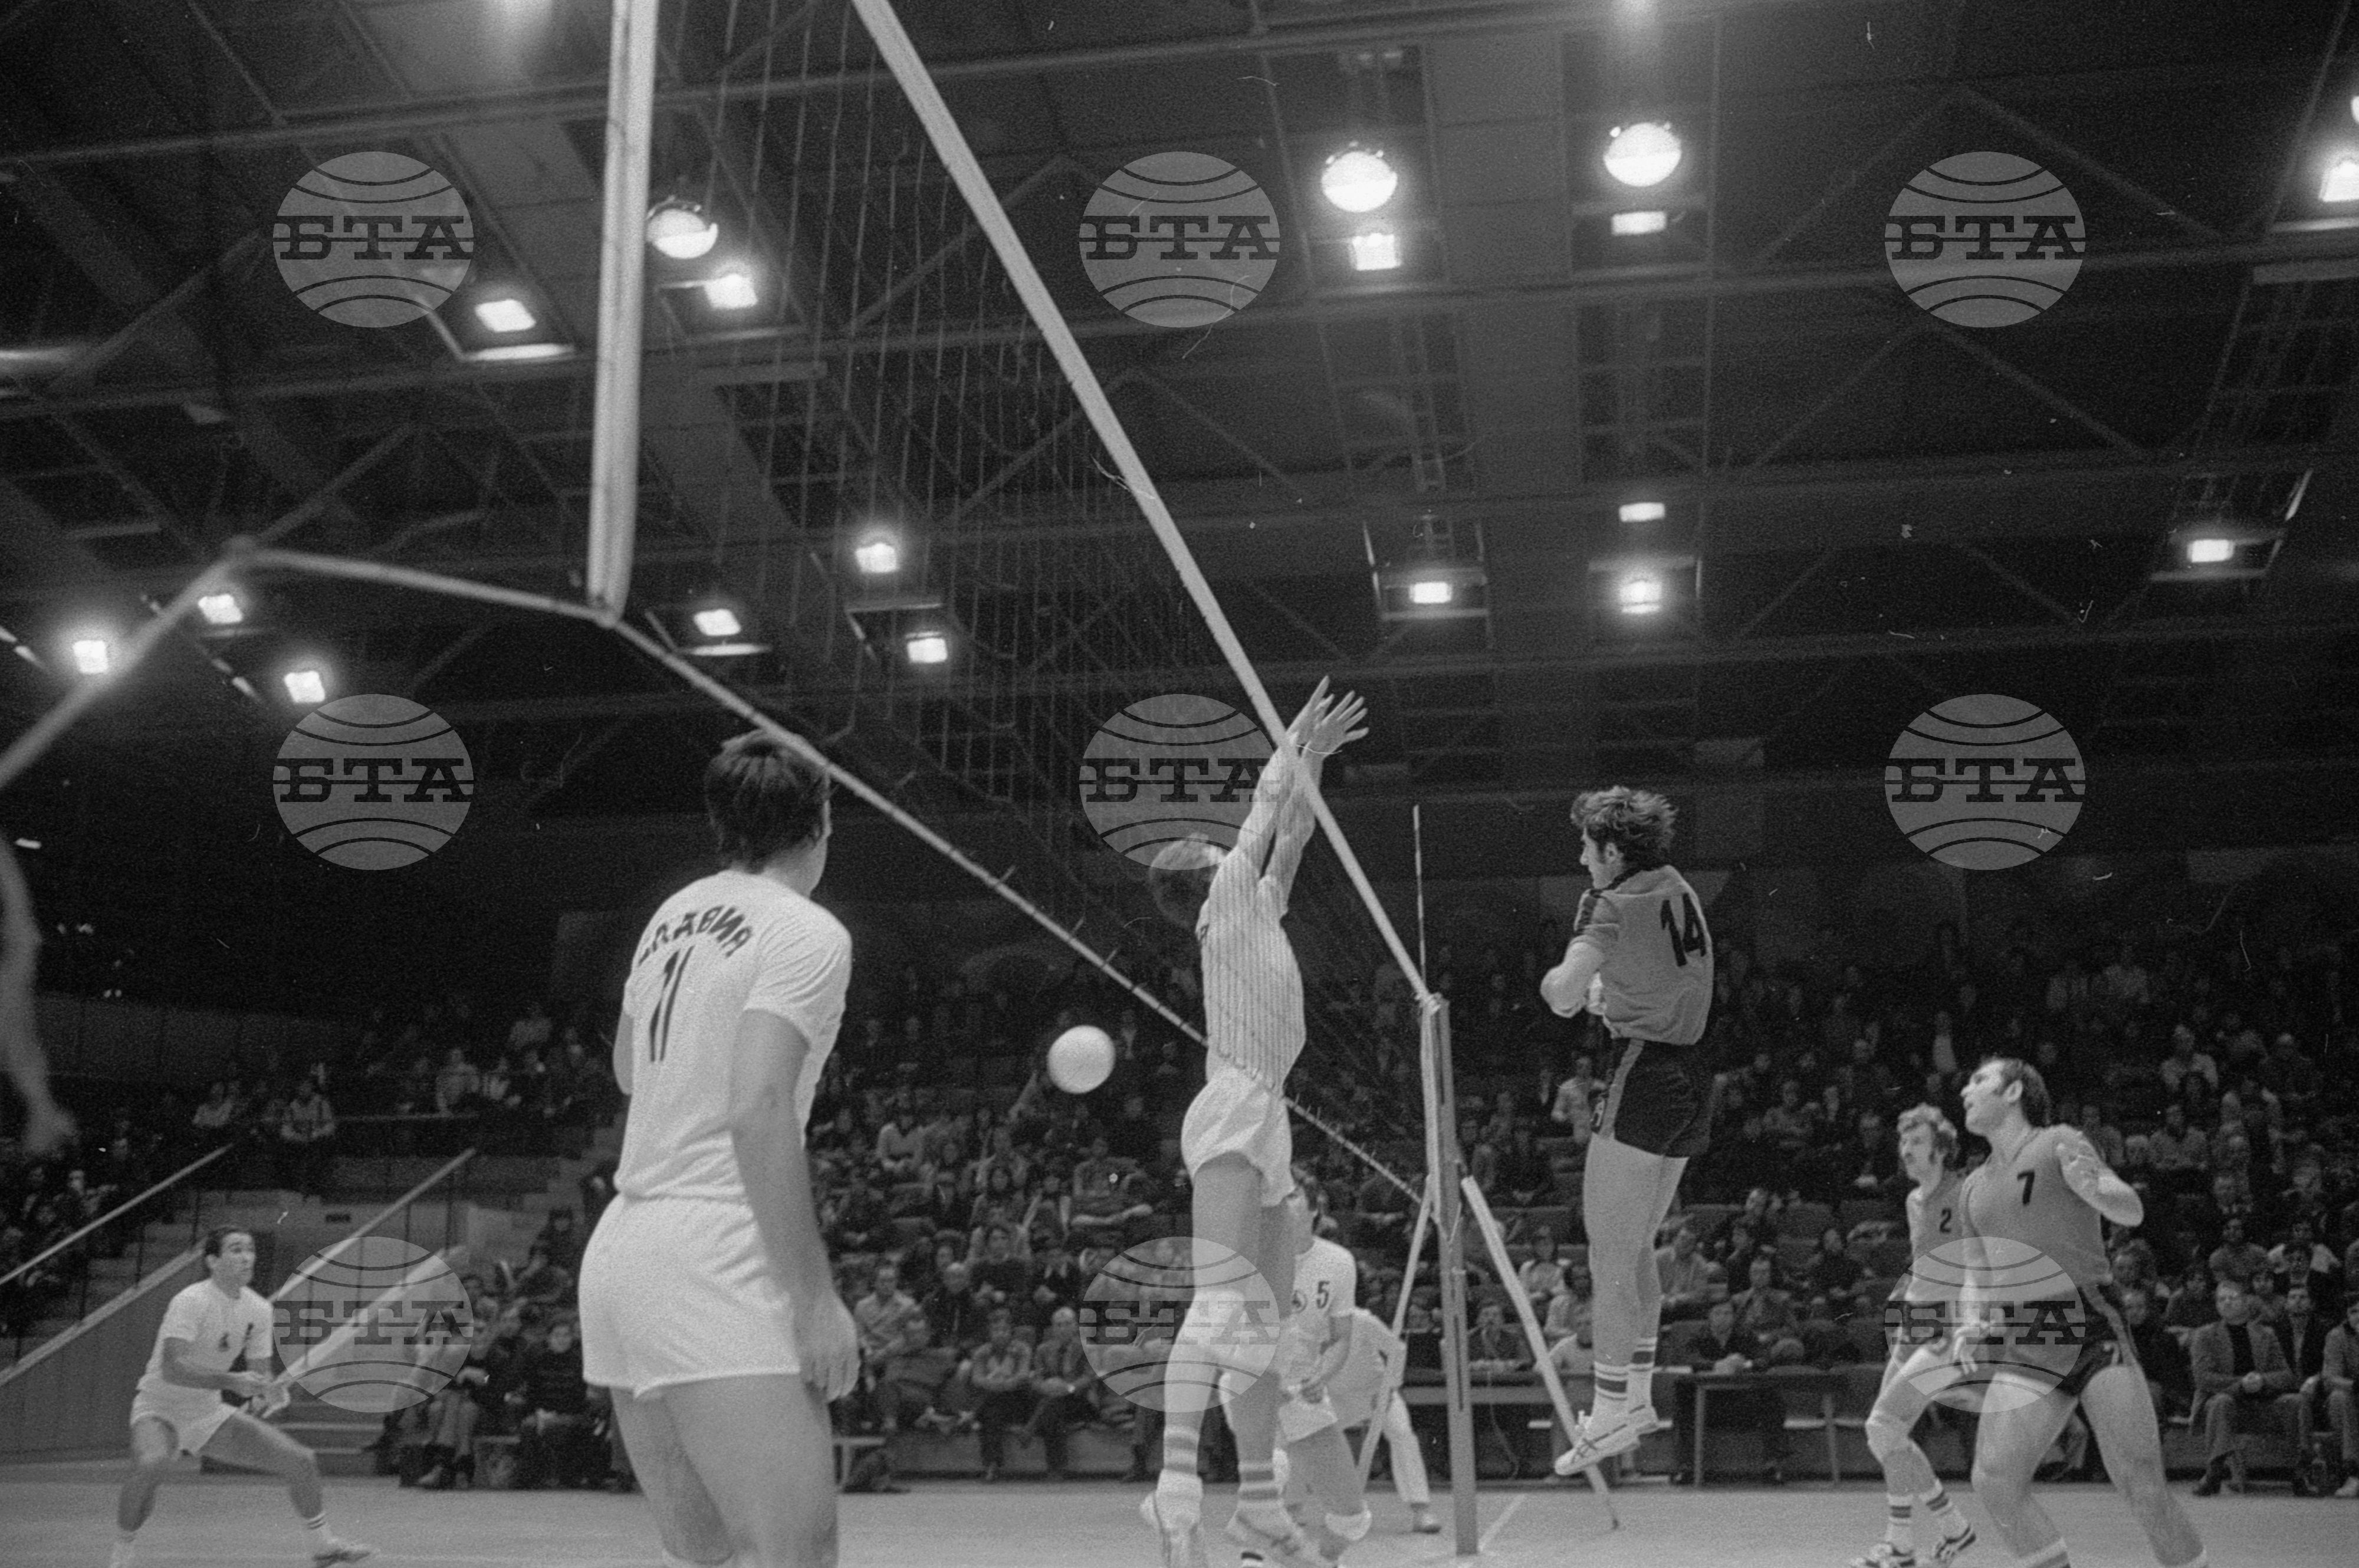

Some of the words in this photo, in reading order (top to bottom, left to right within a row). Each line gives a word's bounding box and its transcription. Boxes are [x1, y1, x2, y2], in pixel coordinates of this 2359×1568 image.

[1661, 893, 1706, 967] 14
[650, 945, 694, 1062] 11
[2018, 1171, 2035, 1205] 7
[1940, 1209, 1951, 1233] 2
[1316, 1281, 1330, 1309] 5
